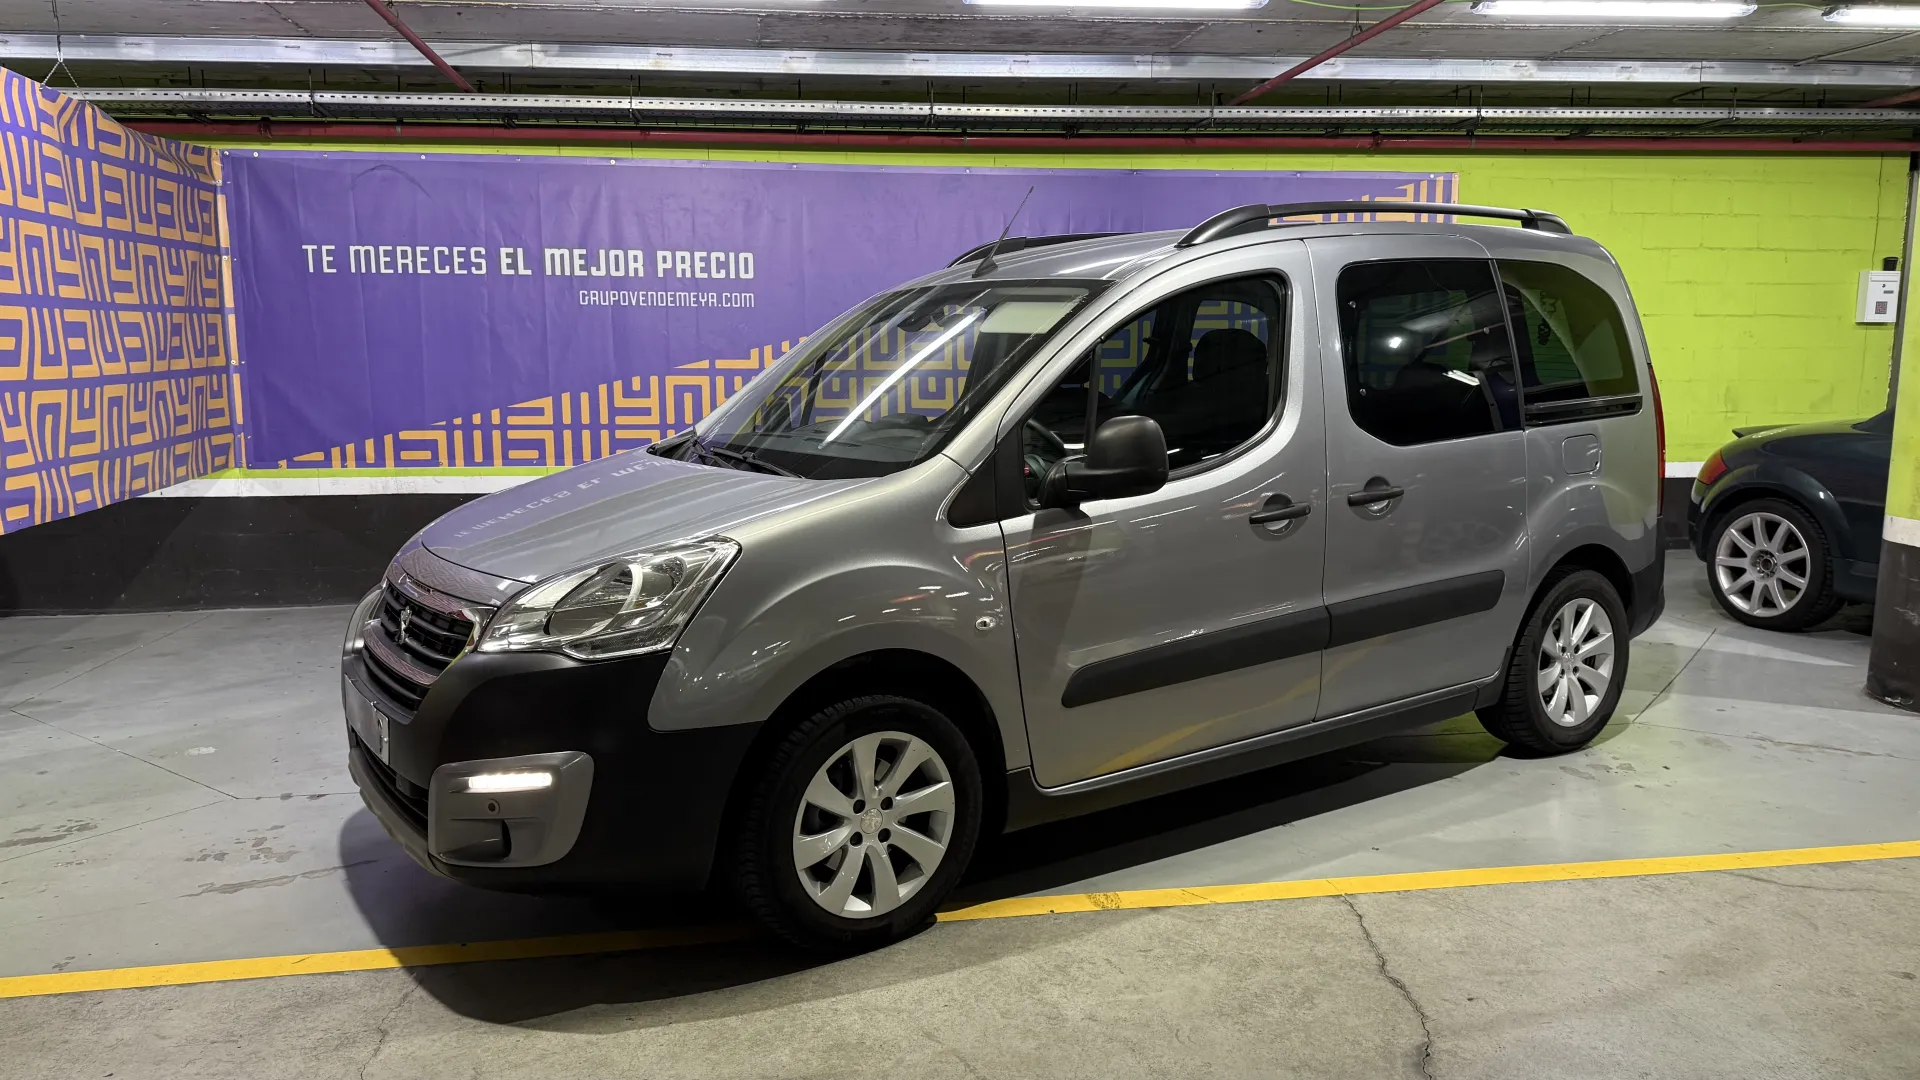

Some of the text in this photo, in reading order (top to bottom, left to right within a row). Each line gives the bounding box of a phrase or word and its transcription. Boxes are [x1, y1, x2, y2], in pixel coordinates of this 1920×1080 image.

[302, 244, 755, 280] TE MERECES EL MEJOR PRECIO
[579, 289, 755, 308] GRUPOVENDEMEYA.COM
